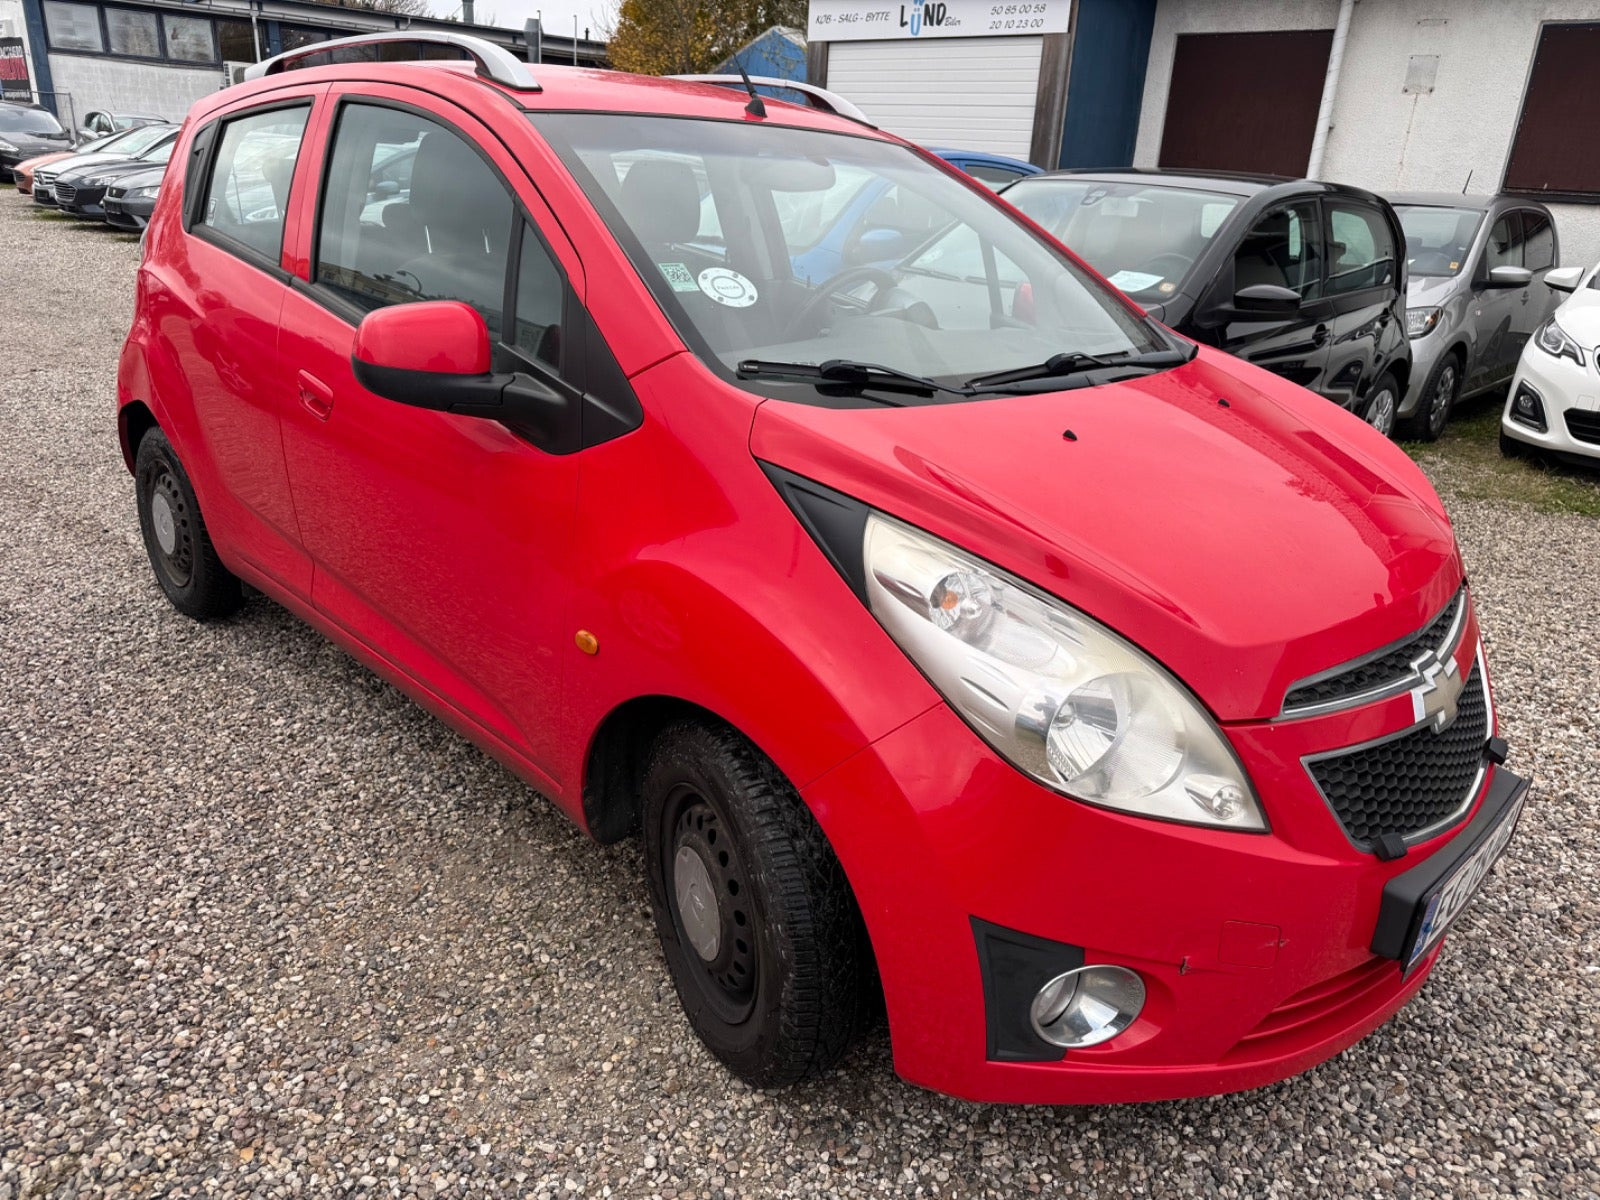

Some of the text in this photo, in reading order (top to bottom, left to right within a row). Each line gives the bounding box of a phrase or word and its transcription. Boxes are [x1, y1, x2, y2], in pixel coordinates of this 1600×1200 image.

[990, 3, 1046, 15] 50 85 00 58
[838, 13, 859, 24] SALG
[865, 11, 890, 22] BYTTE
[989, 18, 1044, 29] 20 10 23 00
